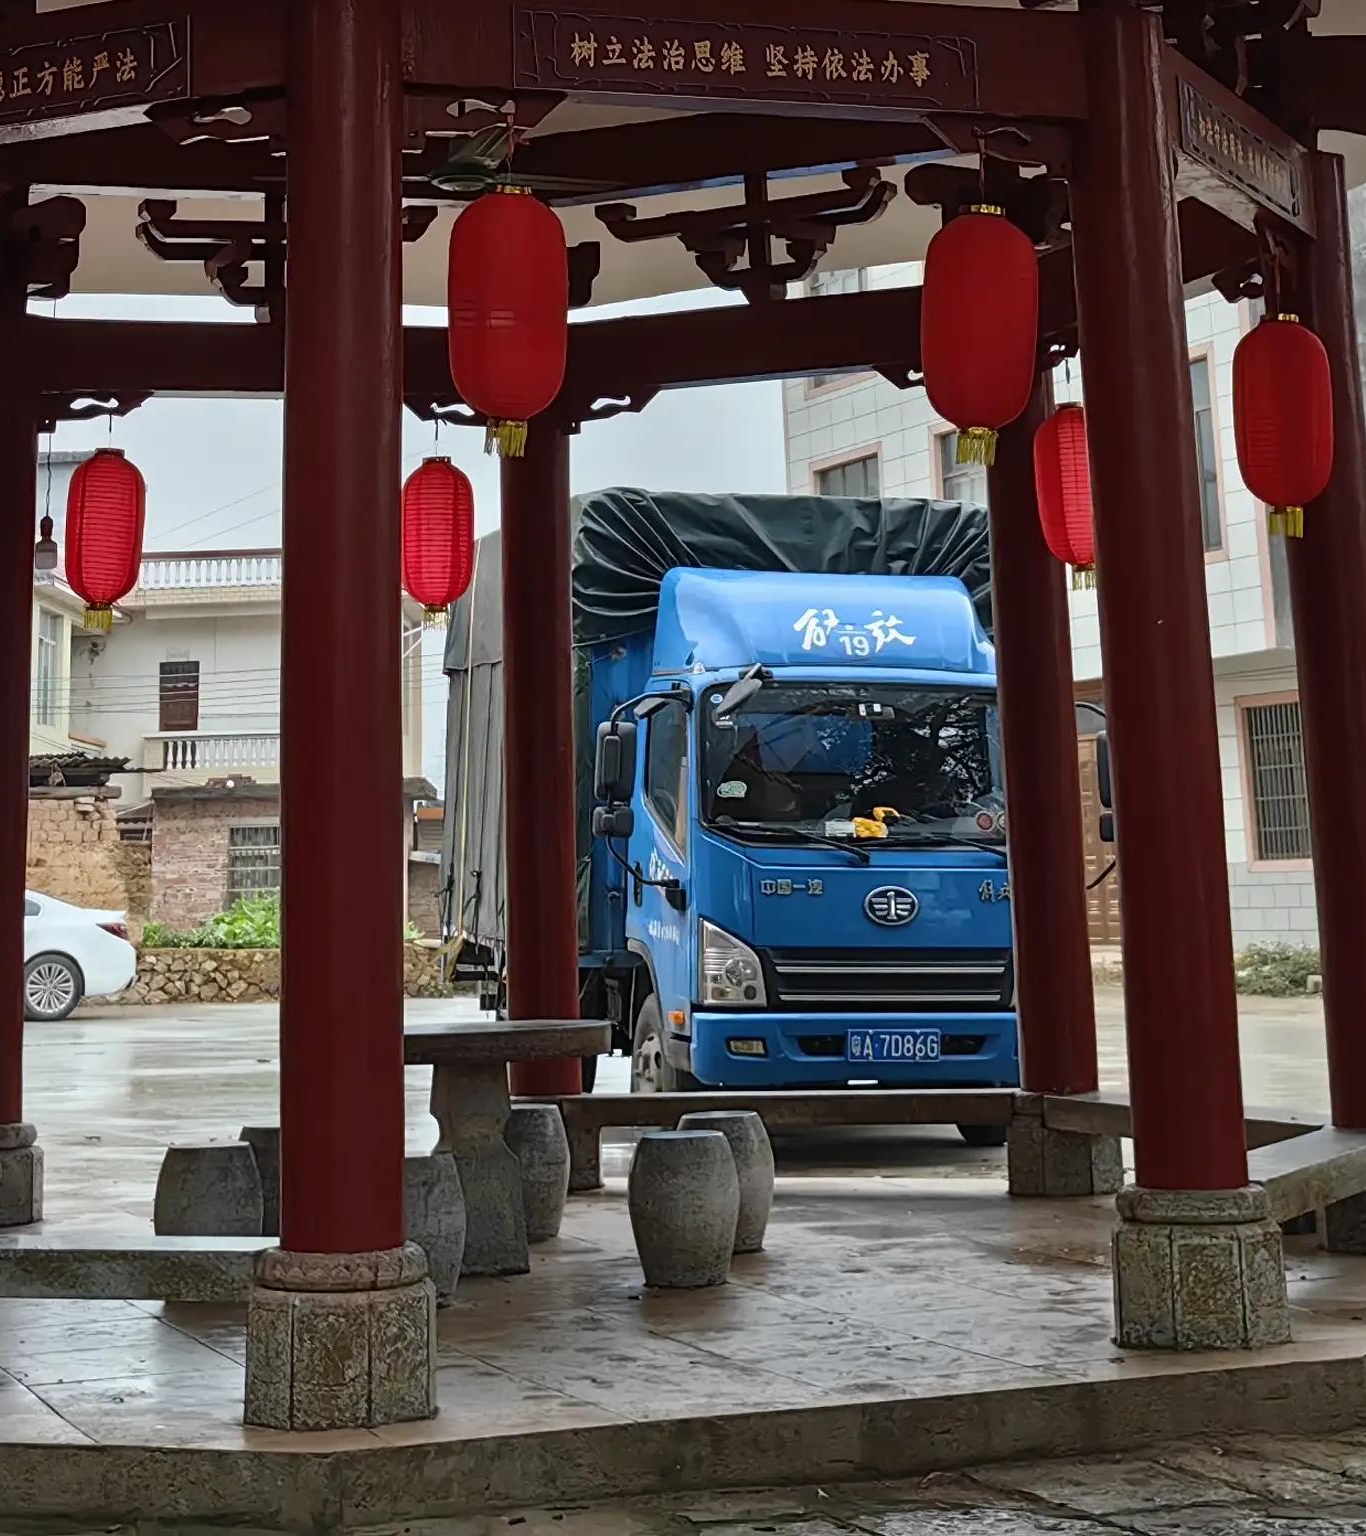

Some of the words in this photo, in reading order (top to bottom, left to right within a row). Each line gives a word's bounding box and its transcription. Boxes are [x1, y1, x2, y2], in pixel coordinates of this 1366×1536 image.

[570, 31, 746, 75] 树立法治思维
[764, 43, 932, 88] 坚持依法办事
